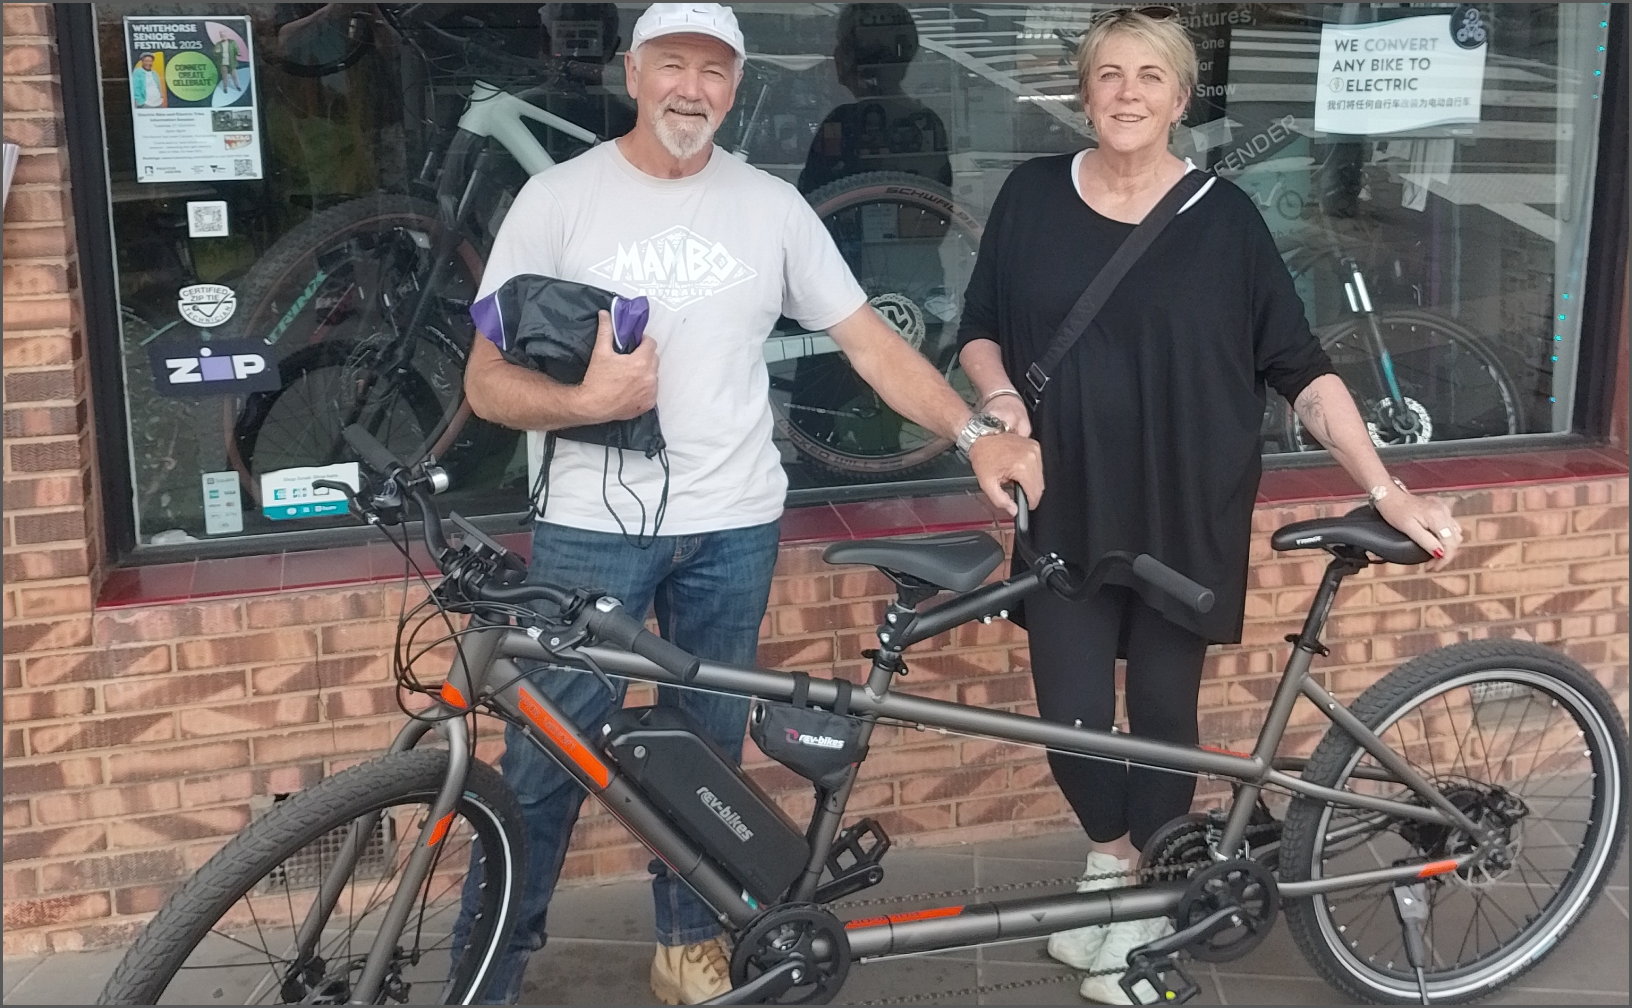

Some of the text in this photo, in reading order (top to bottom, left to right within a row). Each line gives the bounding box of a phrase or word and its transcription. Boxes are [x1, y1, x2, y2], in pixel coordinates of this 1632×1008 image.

[1181, 9, 1257, 28] entures,
[132, 24, 197, 32] WHITEHORSE
[134, 41, 203, 49] FESTIVAL 2025
[1335, 38, 1439, 52] WE CONVERT
[1332, 58, 1431, 72] ANY BIKE TO
[1196, 84, 1236, 97] Snow
[1346, 78, 1418, 92] ELECTRIC
[1206, 114, 1297, 176] FENDER
[885, 186, 979, 230] SCHWALBE
[612, 238, 738, 282] MAMBO
[182, 287, 228, 297] CERTIFIED
[638, 287, 713, 297] AUSTRALIA
[184, 306, 231, 322] TECHNICIAN
[798, 734, 845, 750] rev-bikes
[696, 786, 754, 842] rev-bikes
